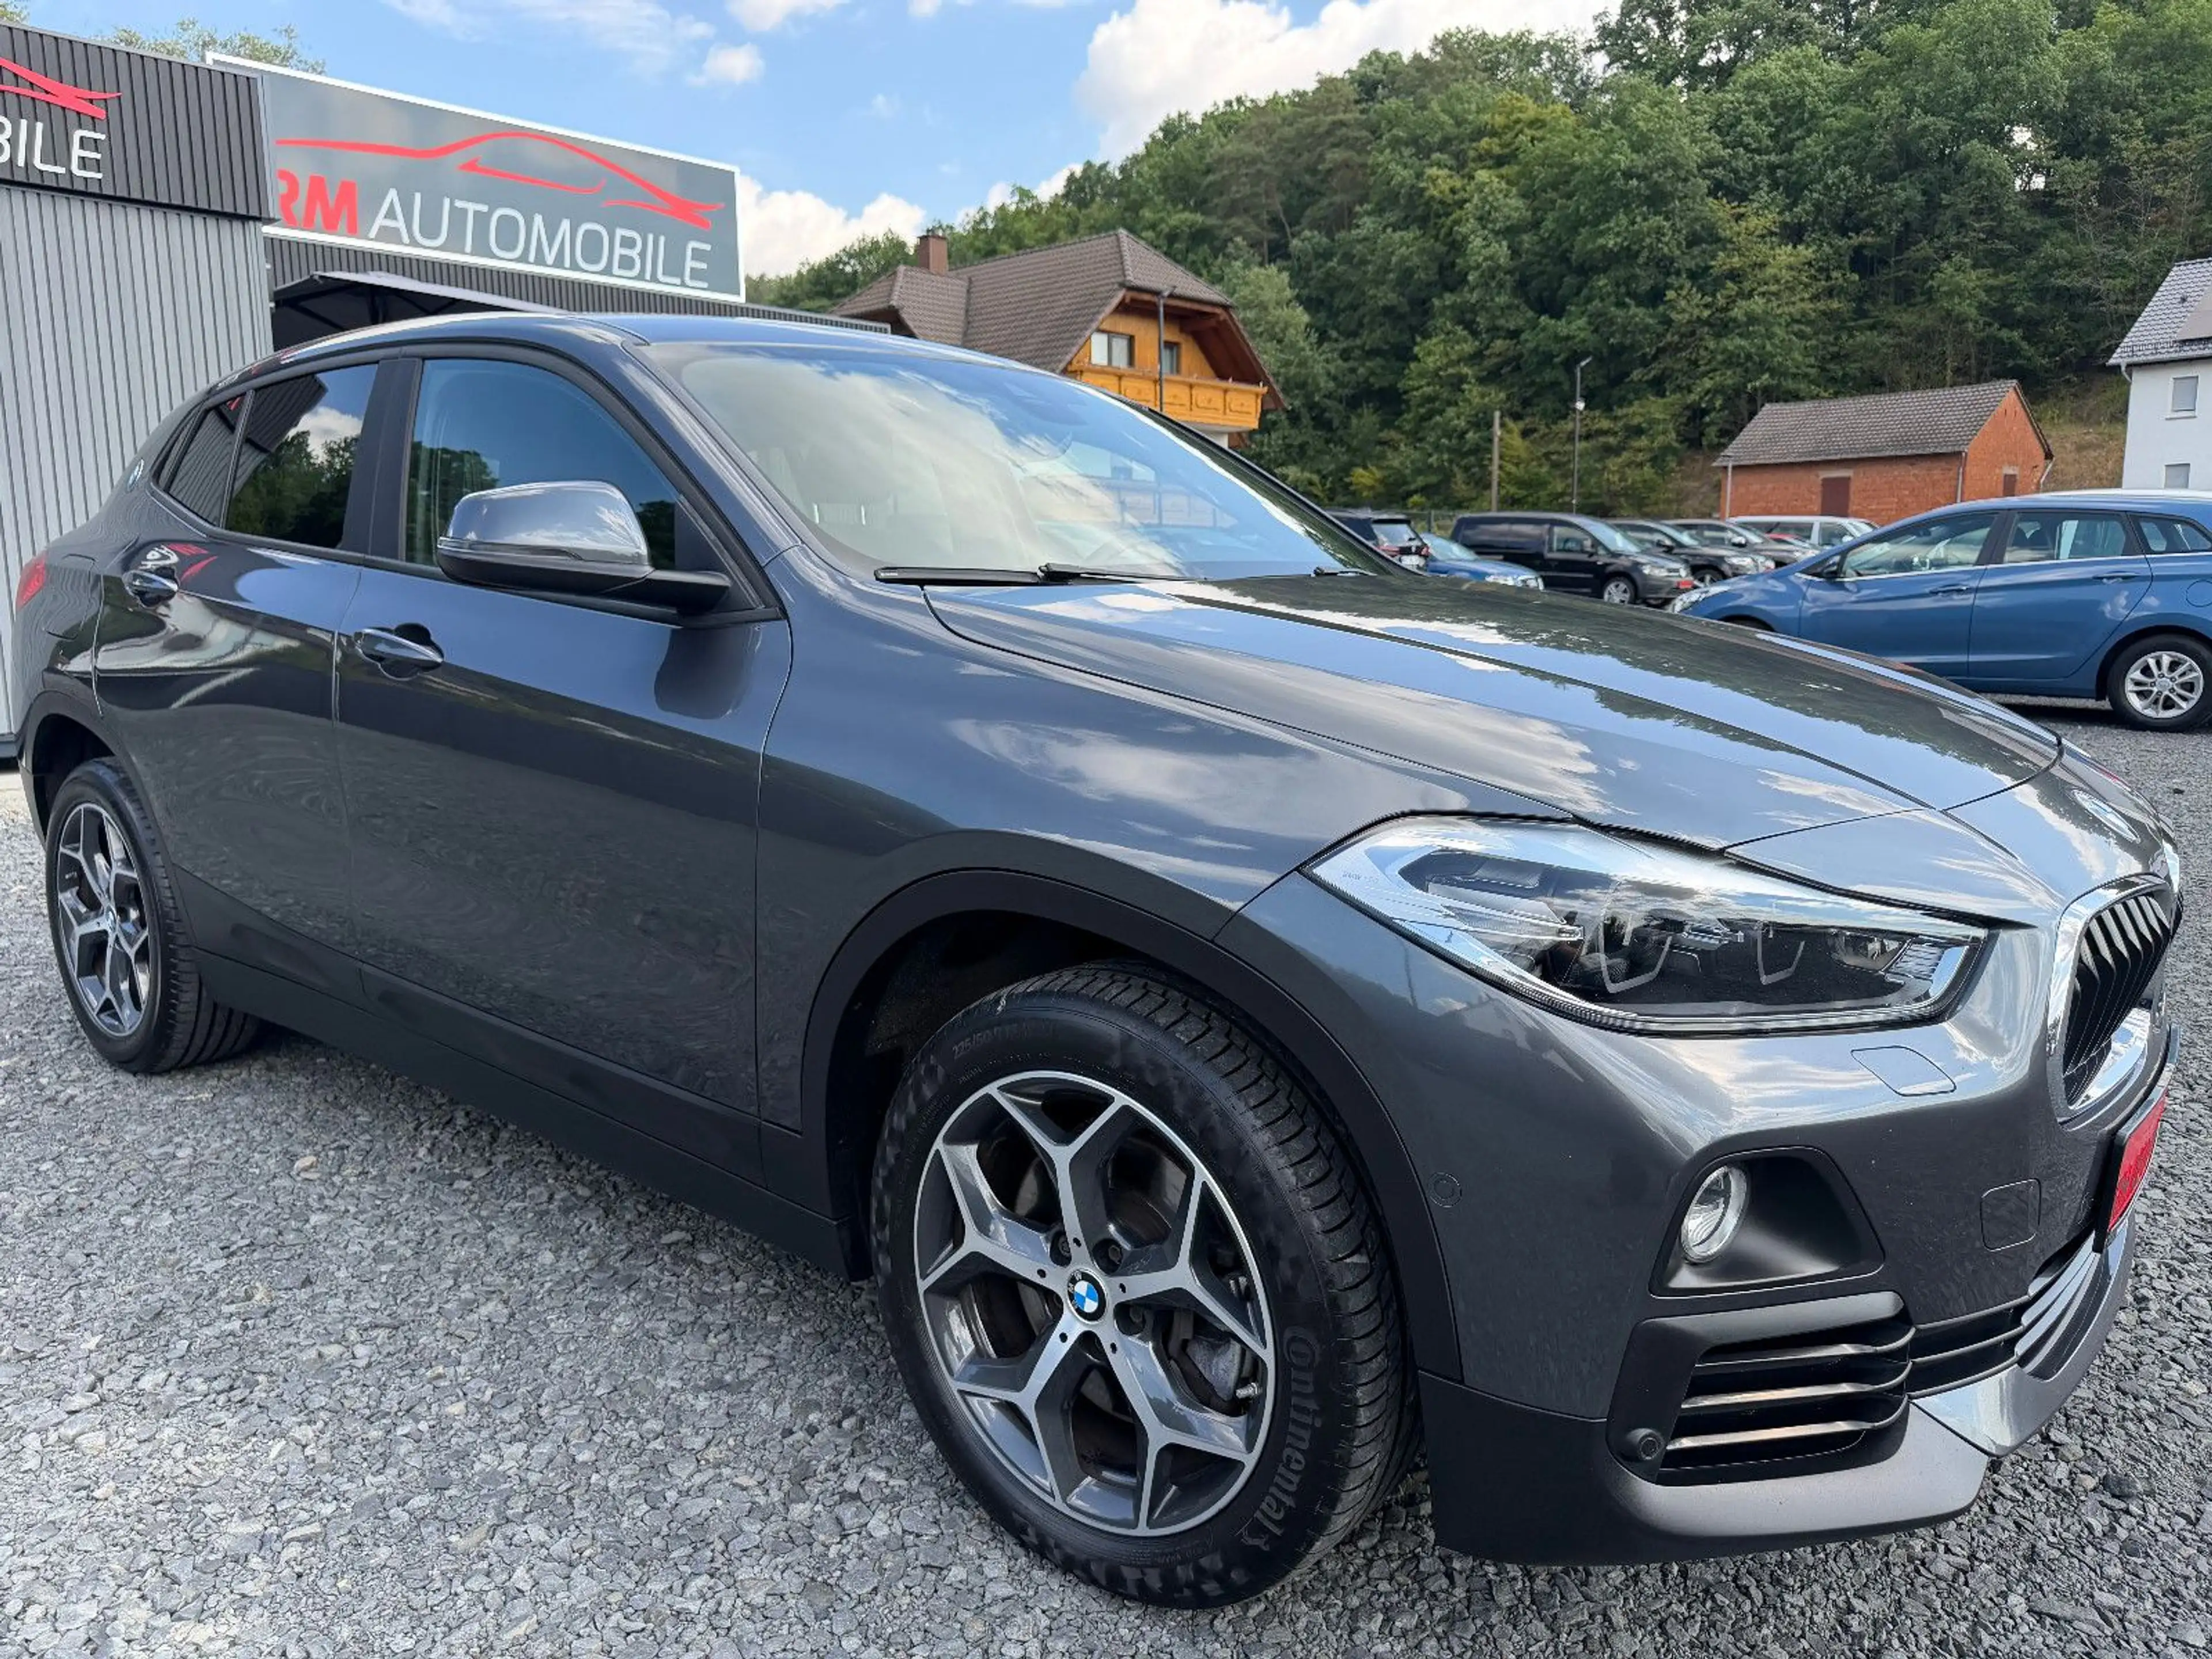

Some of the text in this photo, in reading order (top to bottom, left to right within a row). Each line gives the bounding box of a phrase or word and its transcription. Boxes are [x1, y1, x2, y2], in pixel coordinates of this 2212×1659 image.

[276, 169, 713, 289] RM AUTOMOBILE
[1253, 1325, 1322, 1536] Continental
